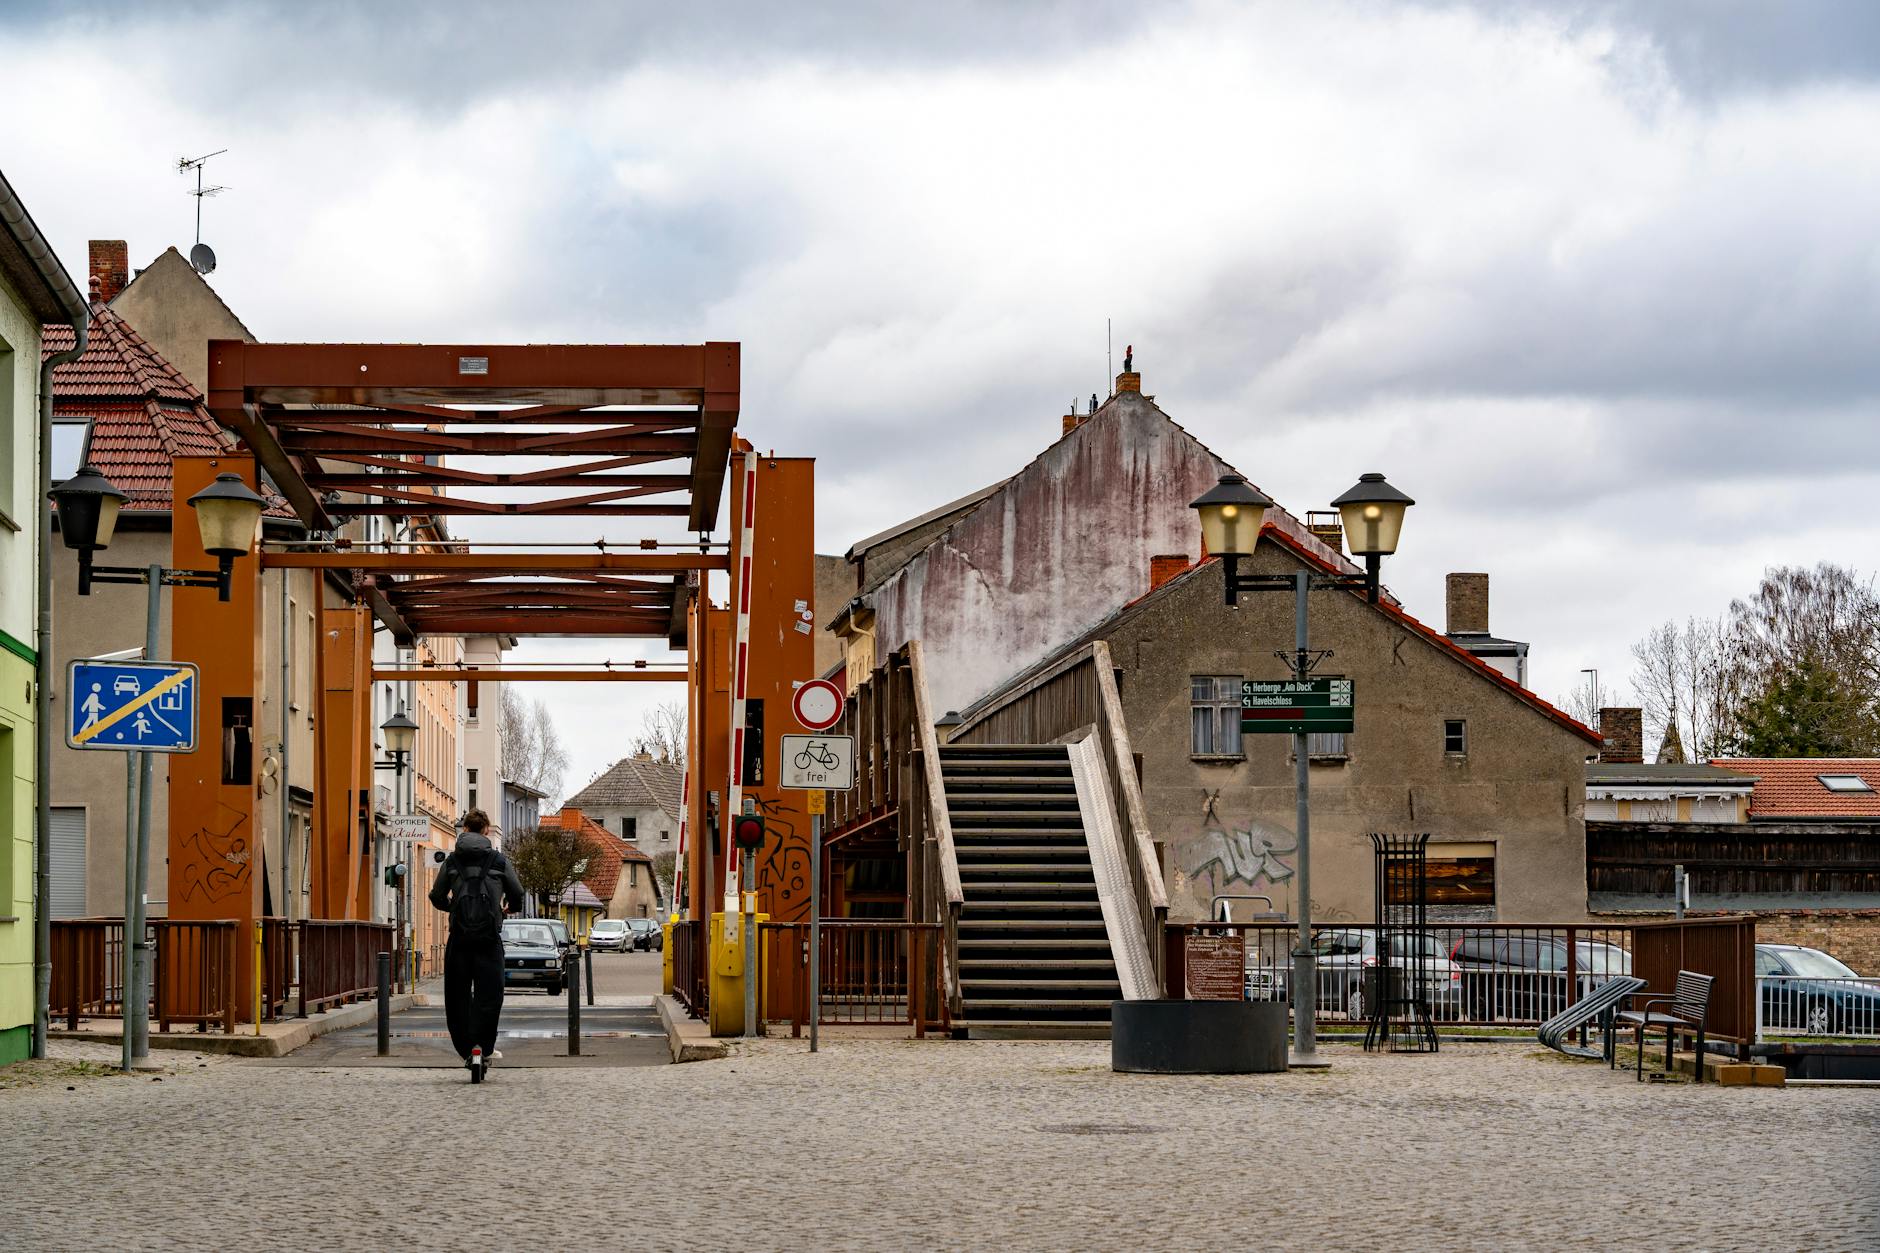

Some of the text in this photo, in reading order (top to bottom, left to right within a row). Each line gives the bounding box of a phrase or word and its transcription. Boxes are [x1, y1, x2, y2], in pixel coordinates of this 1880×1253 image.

[1252, 682, 1281, 694] Herberge
[1252, 696, 1293, 706] Havelschloss
[807, 771, 827, 782] frei
